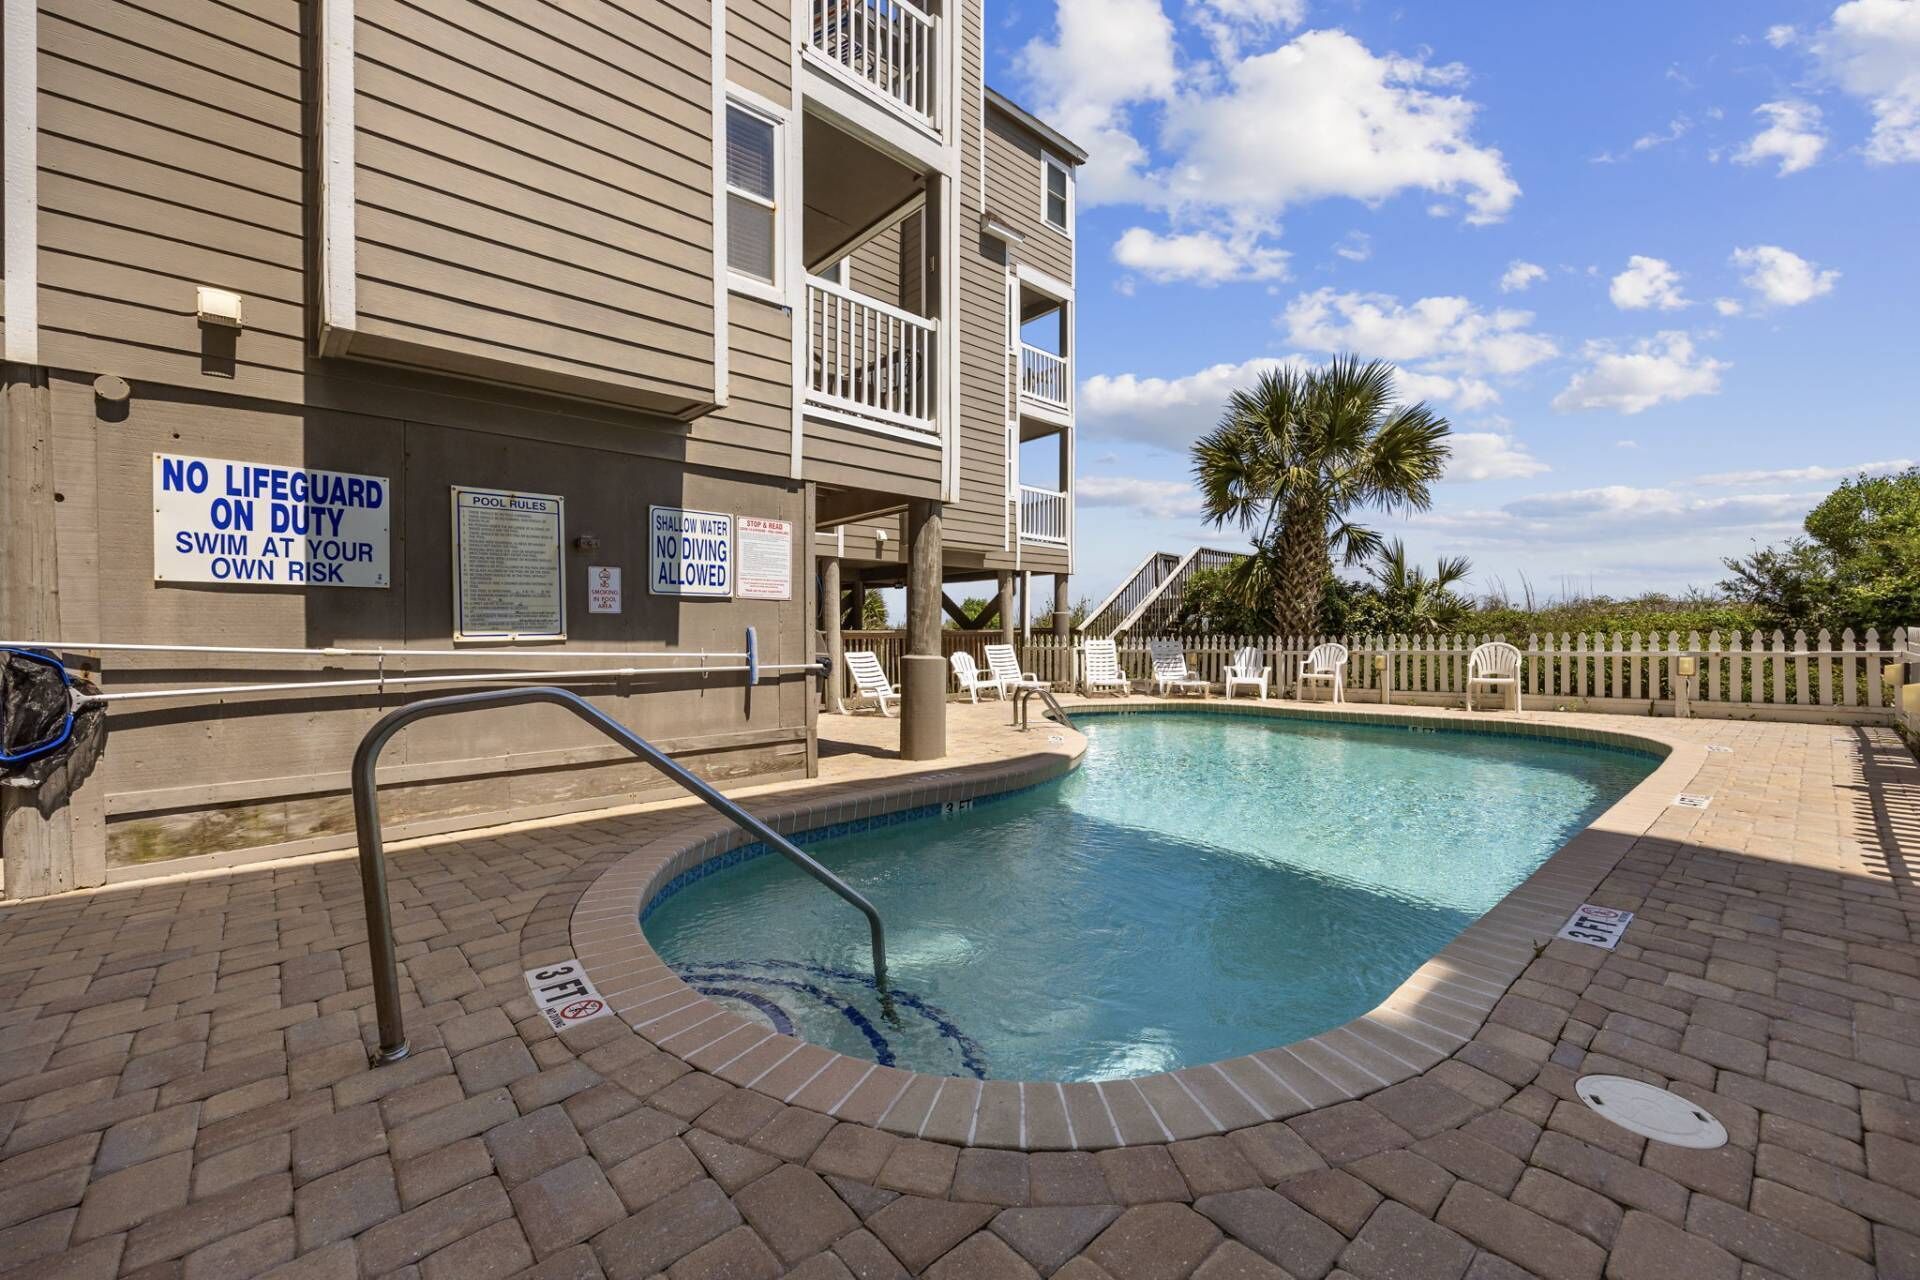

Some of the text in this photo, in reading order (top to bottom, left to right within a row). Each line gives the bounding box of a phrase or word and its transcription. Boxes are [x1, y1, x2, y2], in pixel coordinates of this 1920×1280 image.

[162, 458, 383, 509] NO LIFEGUARD
[472, 496, 547, 511] POOL RULES
[210, 498, 345, 537] ON DUTY
[656, 515, 697, 533] SHALLOW
[701, 519, 728, 536] WATER
[747, 520, 761, 528] STOP
[762, 521, 767, 529] &
[768, 523, 783, 531] READ
[175, 531, 373, 563] SWIM AT YOUR
[657, 535, 677, 559] NO
[682, 537, 727, 562] DIVING
[211, 557, 344, 583] OWN RISK
[658, 561, 726, 587] ALLOWED
[1568, 915, 1617, 942] 3 FT
[535, 966, 589, 1003] 3 FT
